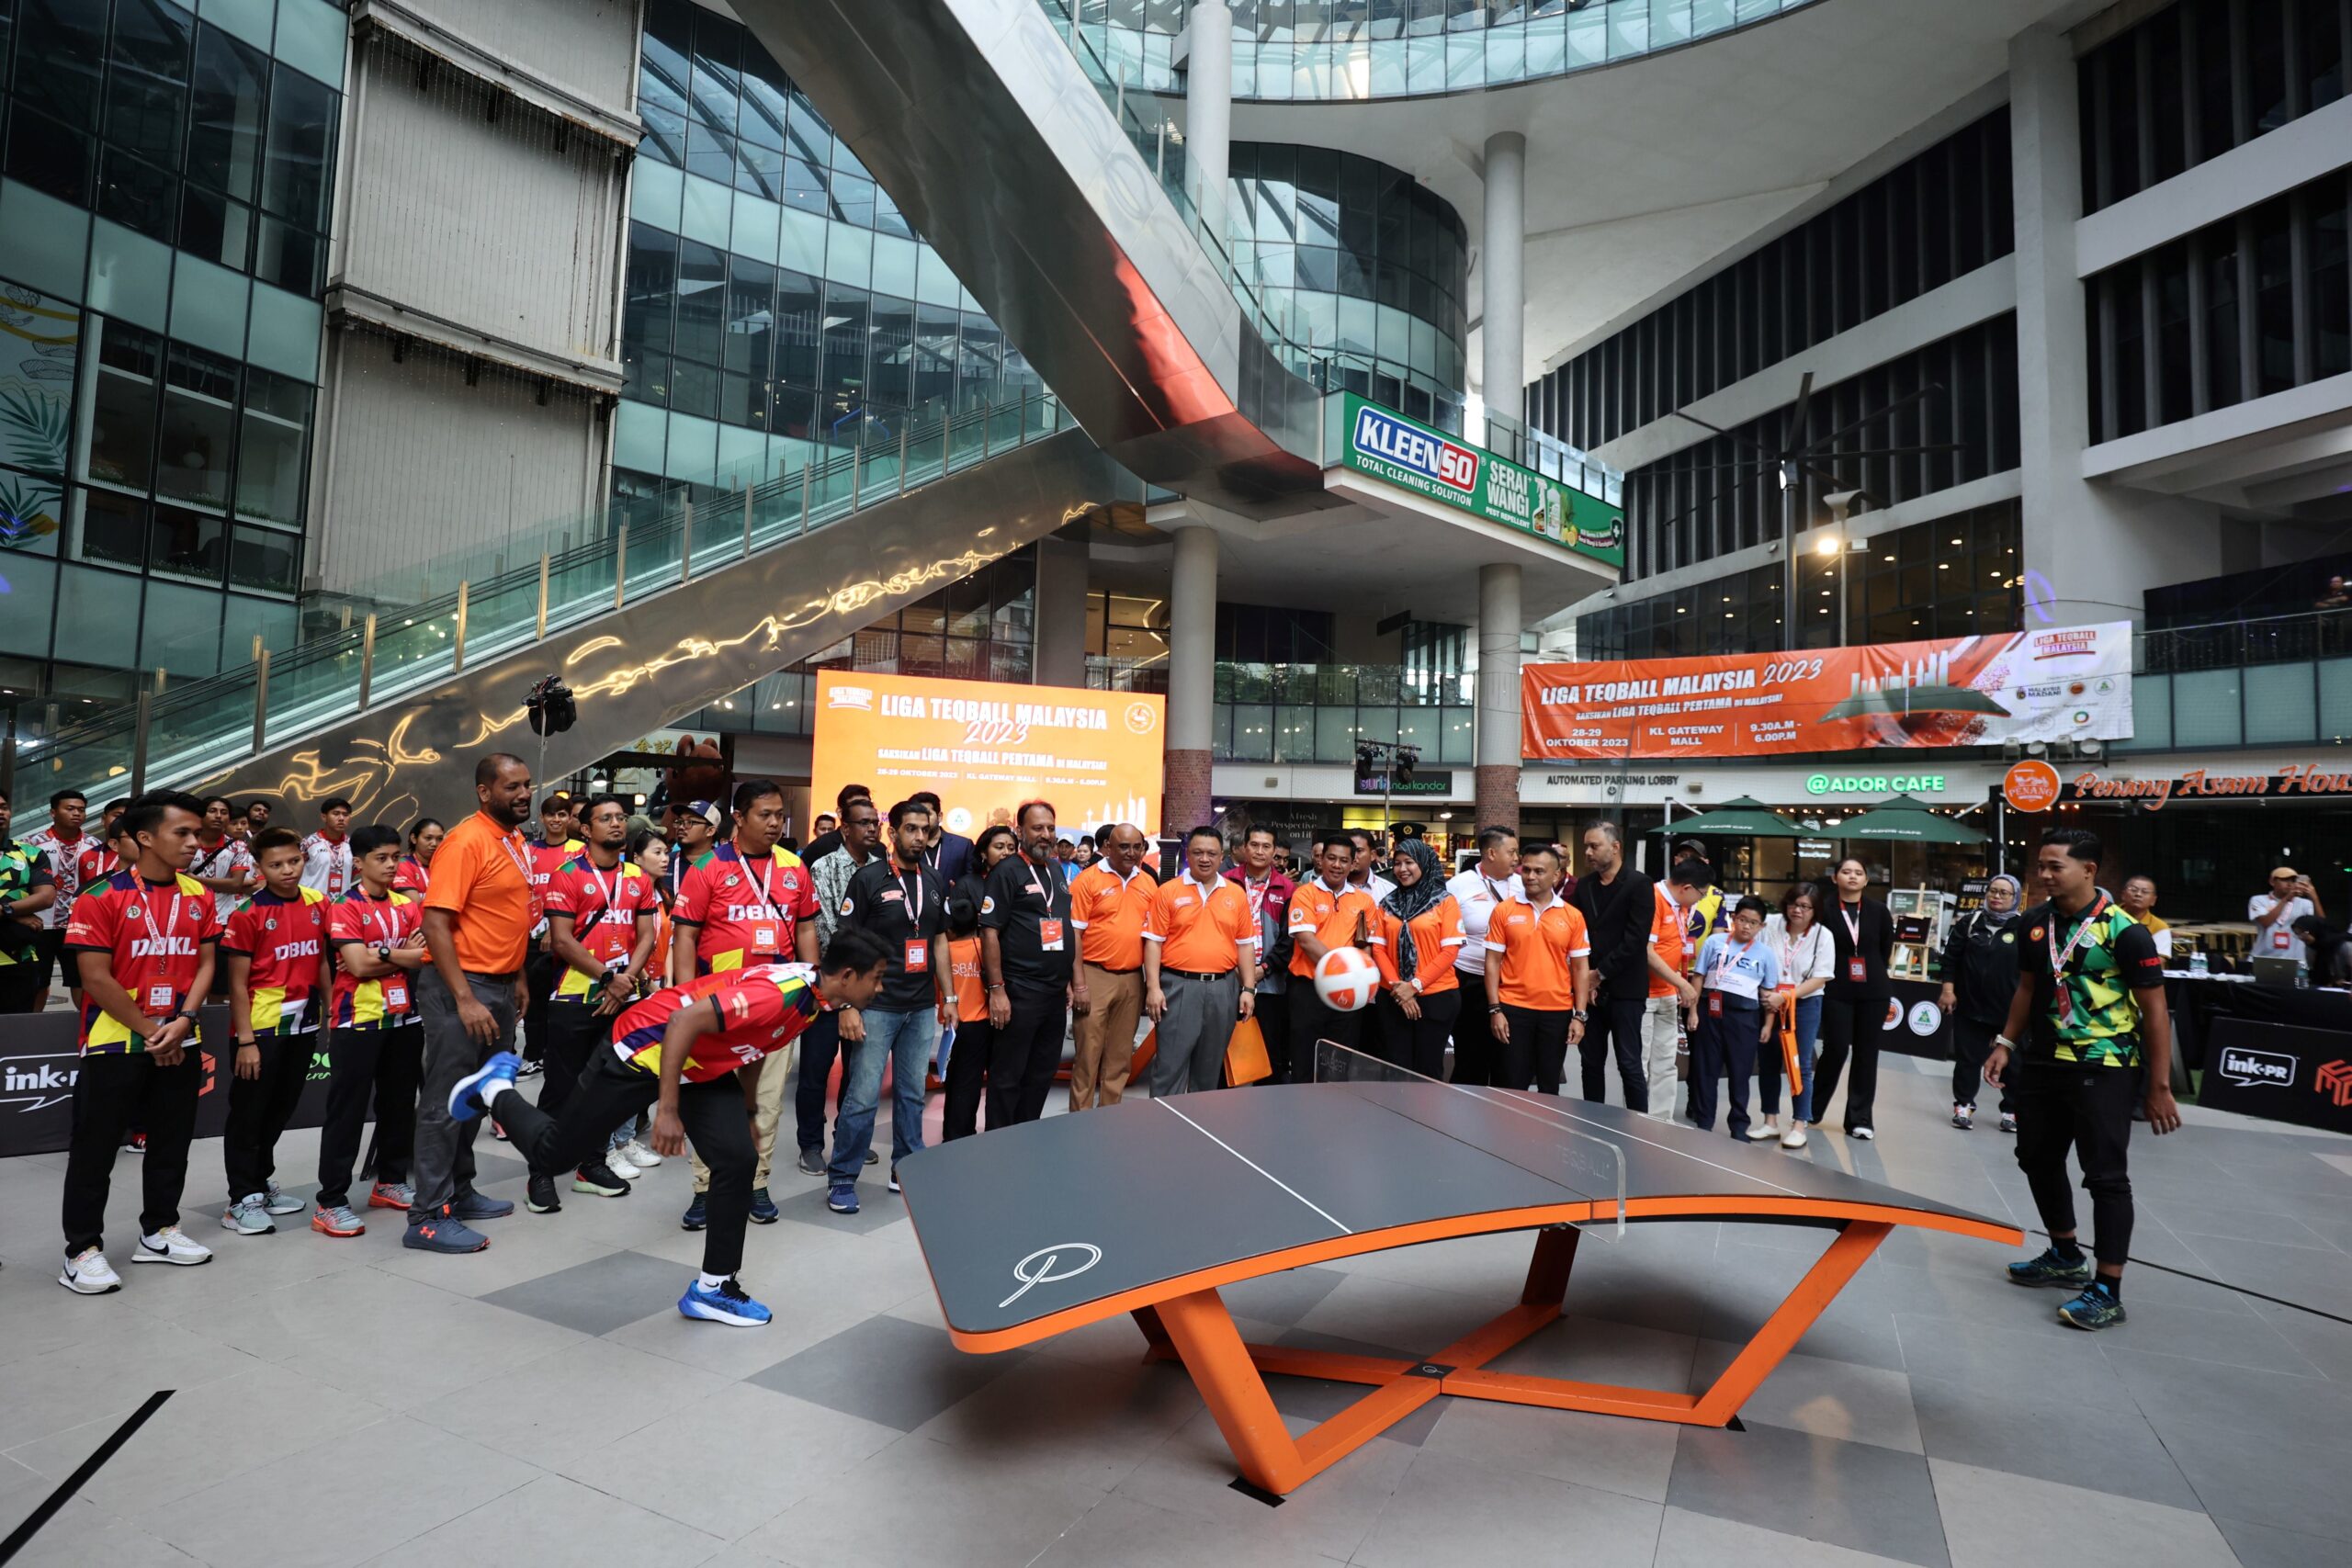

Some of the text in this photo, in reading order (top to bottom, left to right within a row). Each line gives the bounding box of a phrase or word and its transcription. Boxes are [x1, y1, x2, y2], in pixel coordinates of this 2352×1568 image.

[1360, 415, 1473, 485] KLEENSO
[1356, 455, 1472, 506] TOTAL CLEANING SOLUTION
[1487, 480, 1529, 518] WANGI
[1486, 506, 1530, 528] PEST REPELLENT
[1541, 659, 1824, 705] LIGA TEQBALL MALAYSIA 2023
[881, 695, 1107, 729] LIGA TEQBALL MALAYSIA
[1576, 711, 1611, 720] SAKSIKAN
[1612, 706, 1635, 717] LIGA
[1638, 703, 1680, 716] TEQBALL
[1683, 697, 1732, 712] PERTAMA
[1744, 694, 1783, 706] MALAYSIA!
[964, 720, 1029, 745] 2023
[1572, 728, 1601, 737] 28-29
[1649, 725, 1724, 736] KL GATEWAY
[1749, 720, 1794, 732] 9.30A.M
[1546, 739, 1629, 747] OKTOBER 2023
[1670, 737, 1702, 746] MALL
[1755, 731, 1796, 743] 6.00P.M
[922, 748, 948, 761] LIGA
[951, 749, 999, 764] TEQBALL
[1002, 752, 1054, 767] PERTAMA
[979, 773, 1014, 782] GATEWAY
[1413, 778, 1446, 790] kandar
[1547, 775, 1679, 785] AUTOMATED PARKING LOBBY
[1805, 773, 1945, 795] @ADOR CAFE
[2008, 785, 2053, 797] PENANG
[2074, 771, 2173, 810] Penang
[2177, 768, 2268, 795] Asam
[1272, 821, 1317, 829] Perspective
[275, 940, 320, 961] DBKL
